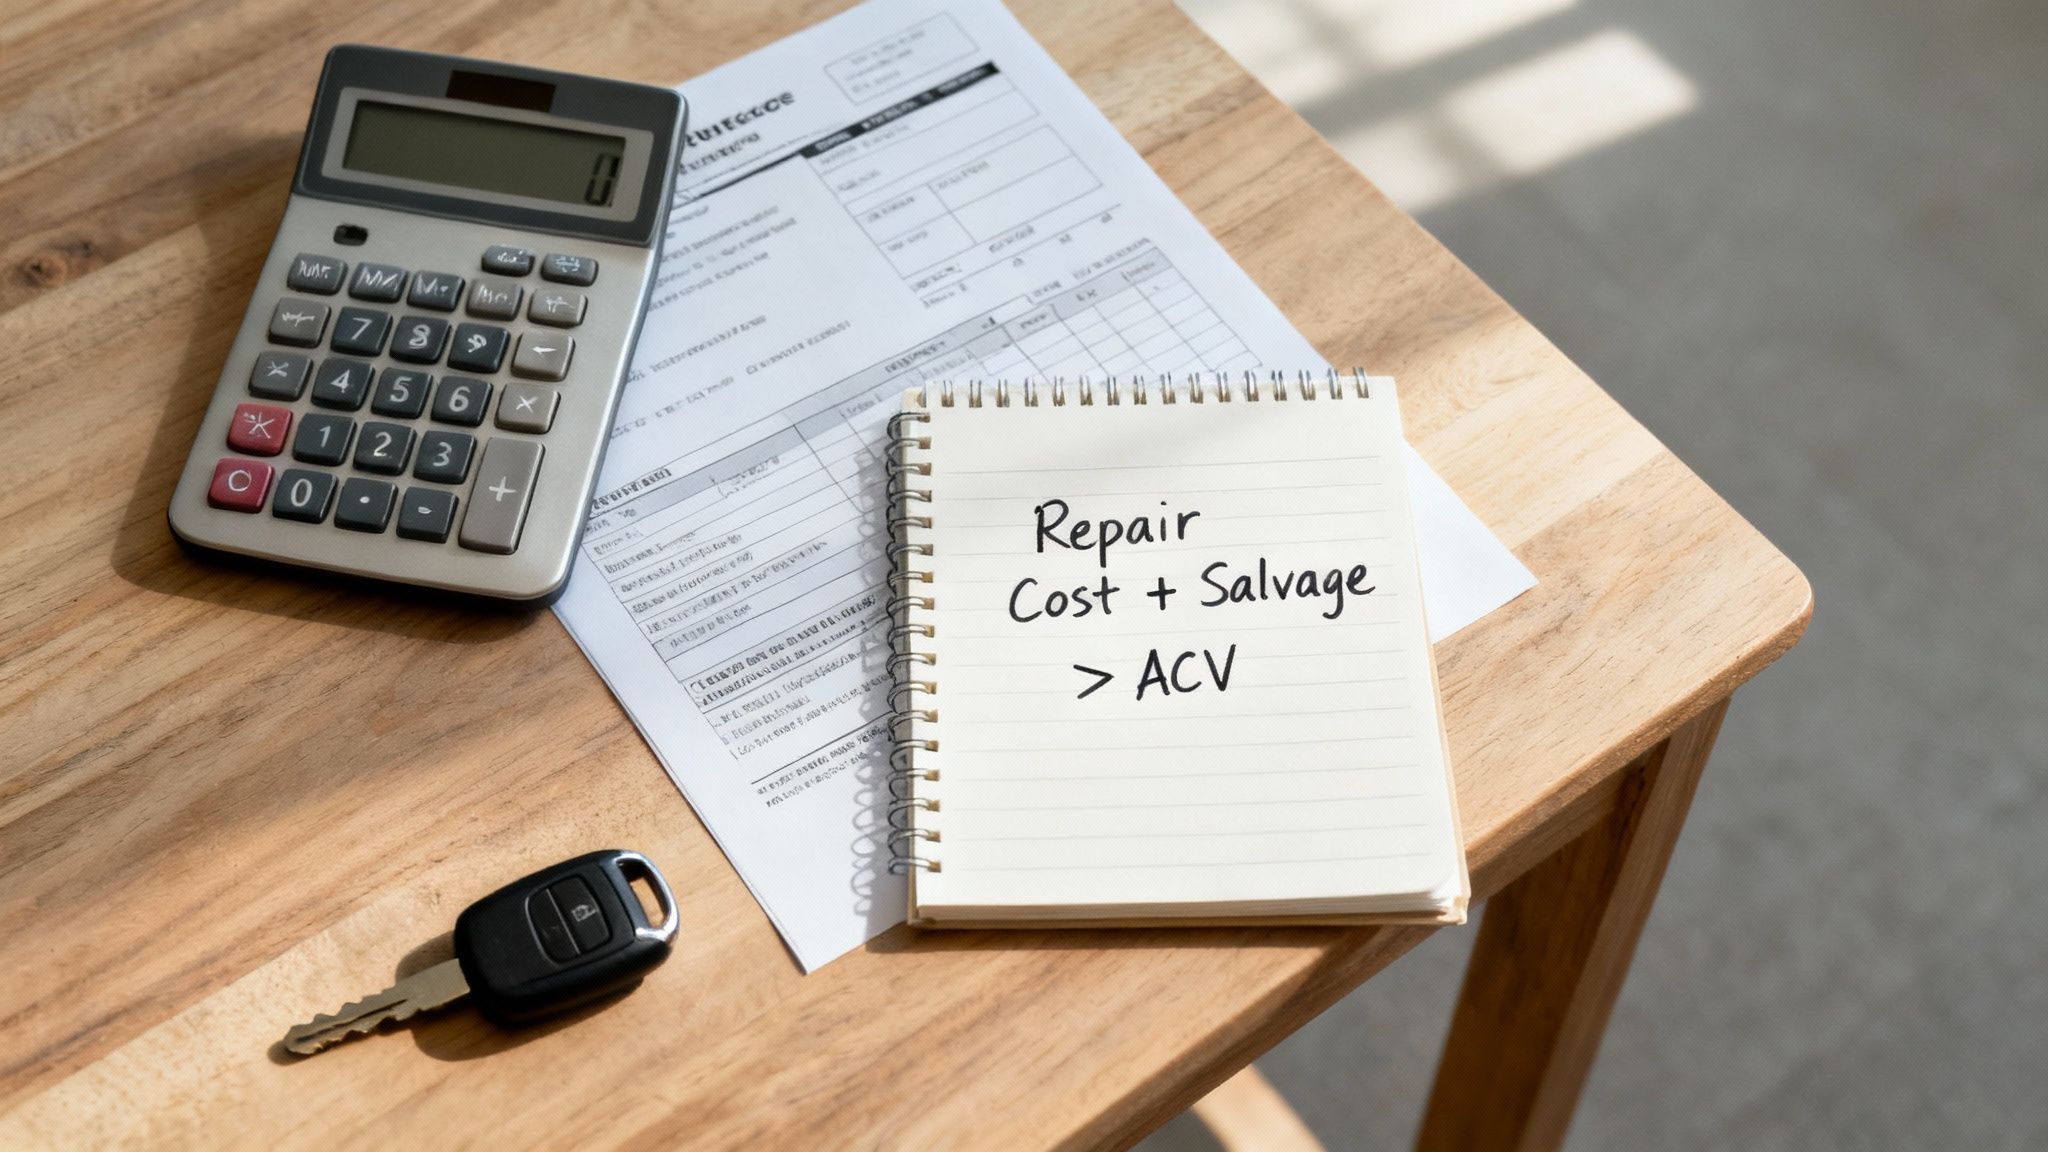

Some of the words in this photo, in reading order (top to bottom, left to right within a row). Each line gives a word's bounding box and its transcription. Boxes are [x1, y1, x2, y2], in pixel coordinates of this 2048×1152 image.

[350, 316, 373, 341] 7
[330, 368, 351, 395] 4
[389, 375, 412, 405] 5
[448, 385, 471, 412] 6
[318, 425, 331, 449] 1
[372, 431, 393, 458] 2
[431, 441, 453, 468] 3
[289, 477, 314, 508] 0
[1034, 498, 1201, 569] Repair
[1008, 575, 1121, 623] Cost
[1146, 576, 1177, 611] +
[1200, 557, 1376, 620] Salvage
[1073, 664, 1115, 700] >
[1136, 643, 1237, 701] ACV
